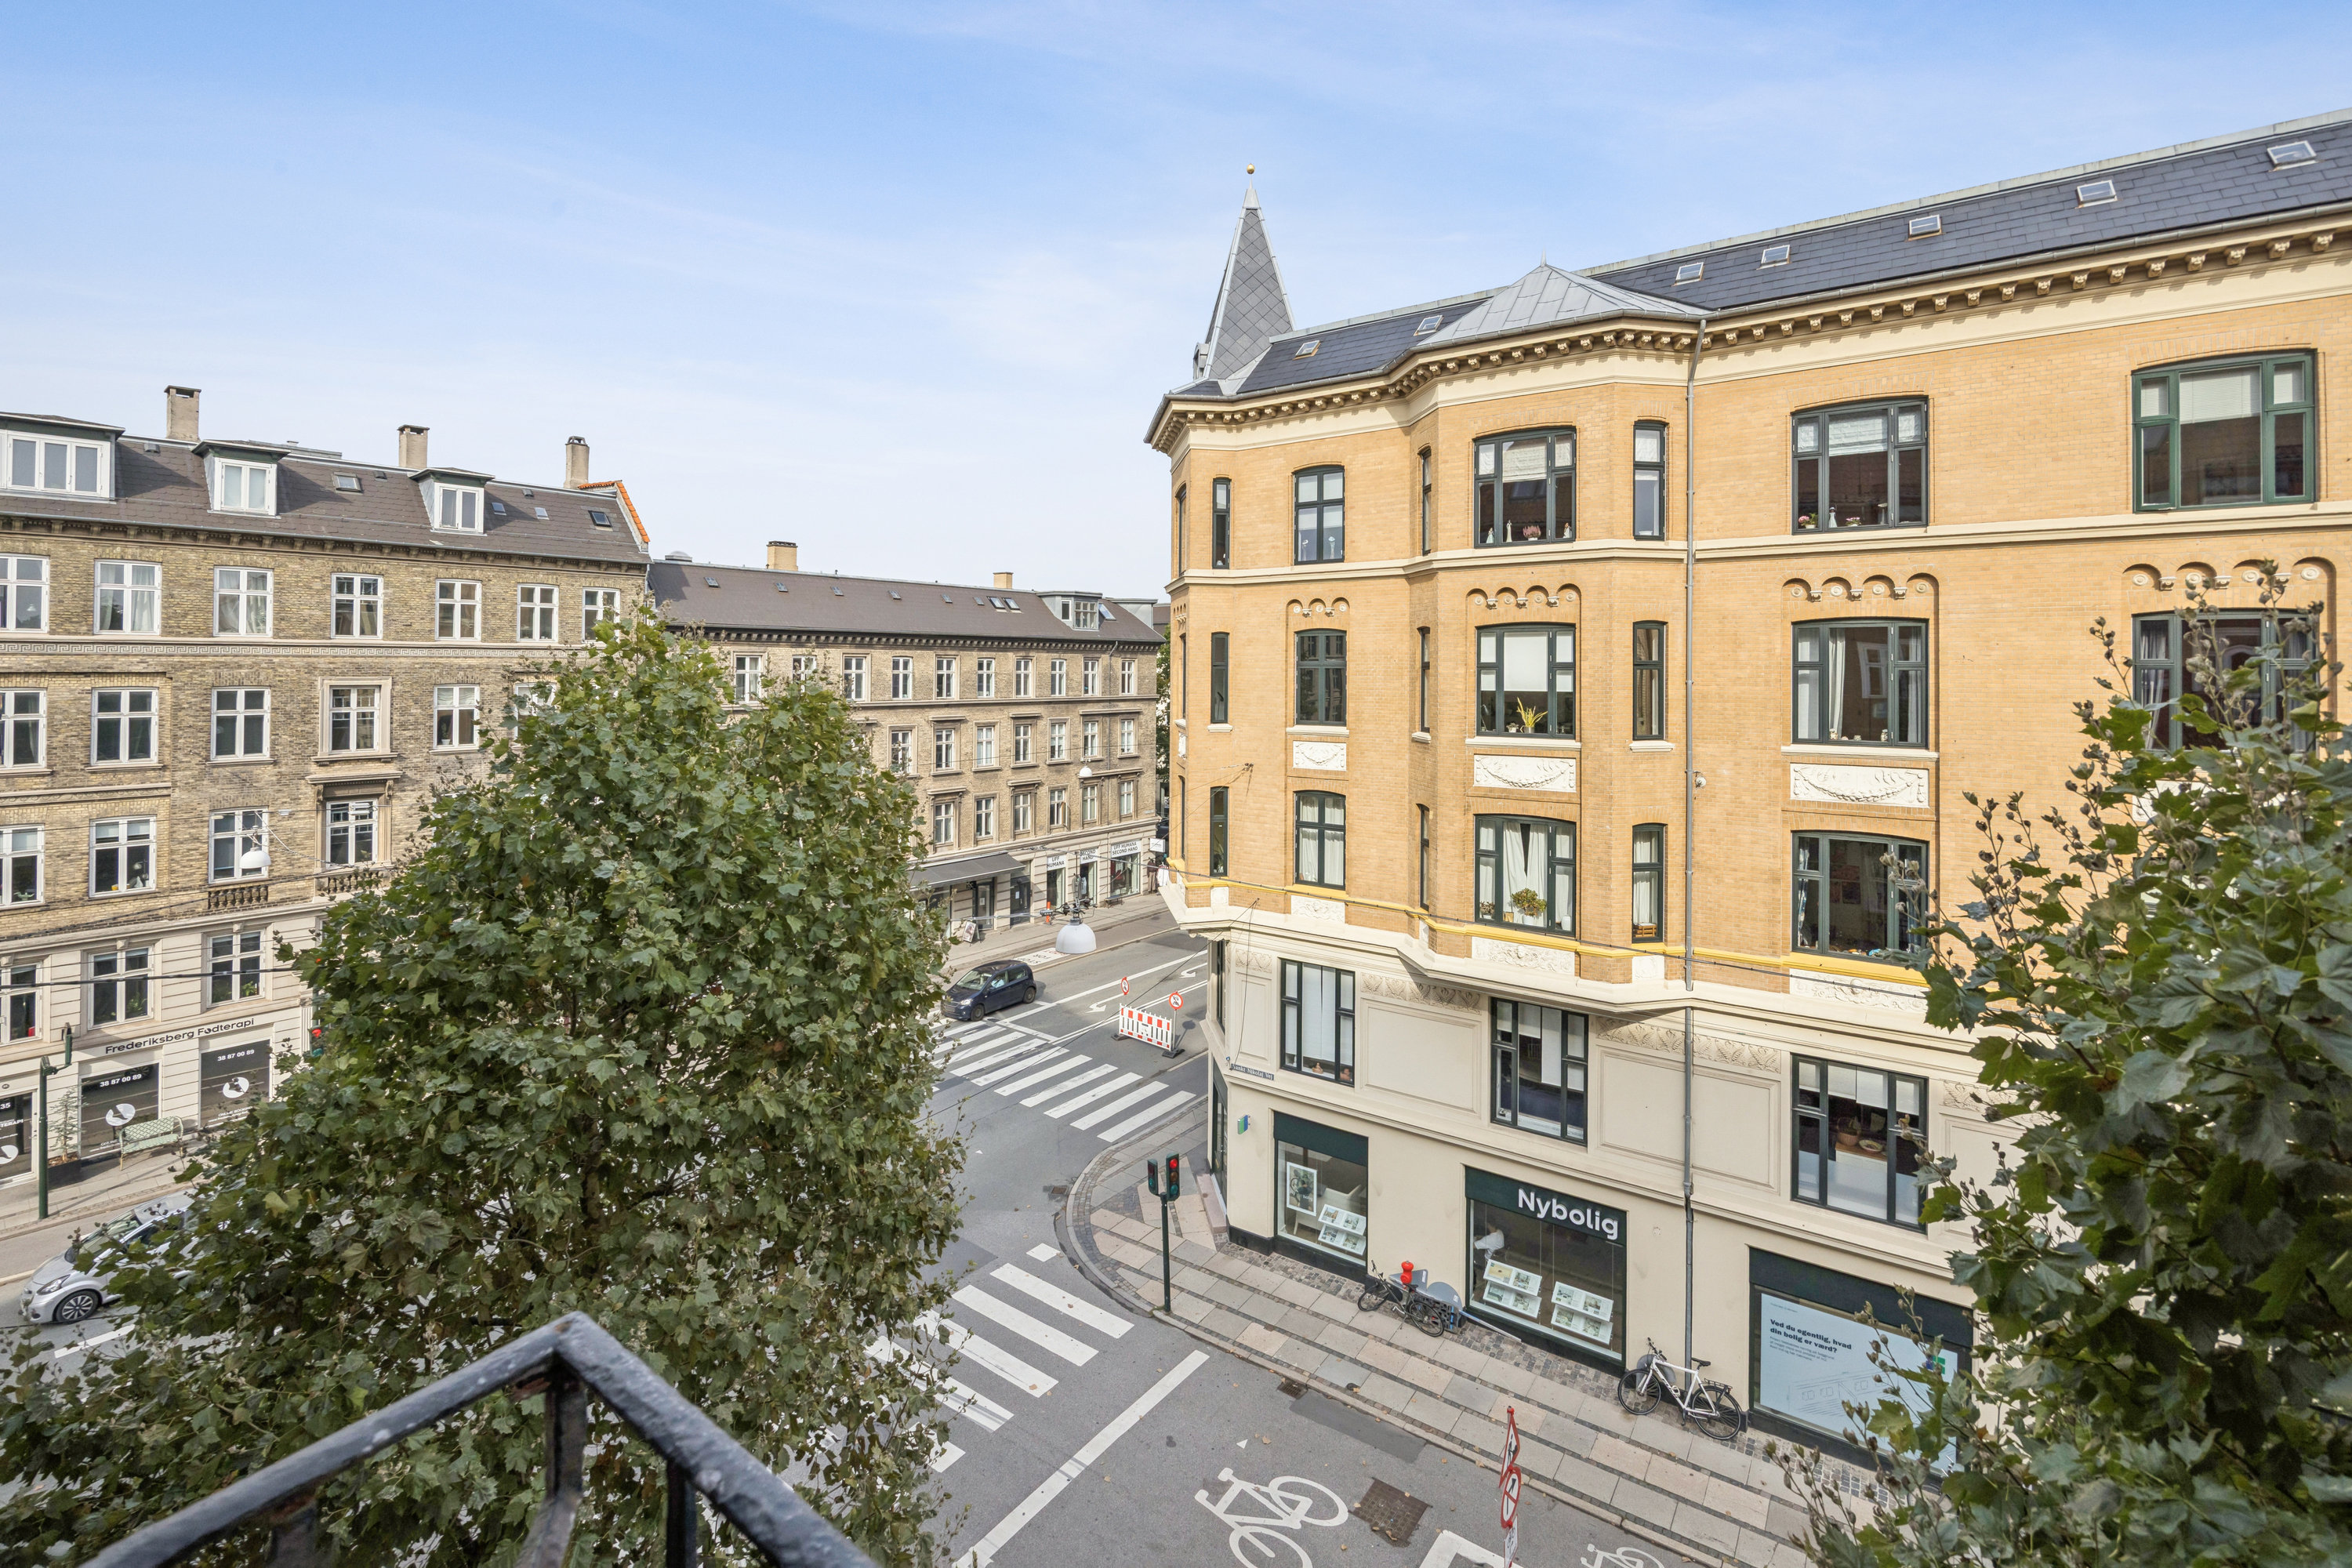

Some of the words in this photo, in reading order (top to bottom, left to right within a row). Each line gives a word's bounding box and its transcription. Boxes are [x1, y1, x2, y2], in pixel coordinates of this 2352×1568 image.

[105, 1031, 194, 1054] Frederiksberg
[1232, 1064, 1246, 1073] Sankt
[1247, 1068, 1264, 1078] Nikolaj
[1265, 1072, 1273, 1080] Vej
[0, 1118, 24, 1127] TERAPI
[1518, 1188, 1618, 1240] Nybolig
[1770, 1319, 1784, 1328] Ved
[1797, 1329, 1831, 1344] egentlig,
[1833, 1339, 1852, 1349] hvad
[1784, 1331, 1802, 1343] bolig
[1814, 1341, 1838, 1353] værd?
